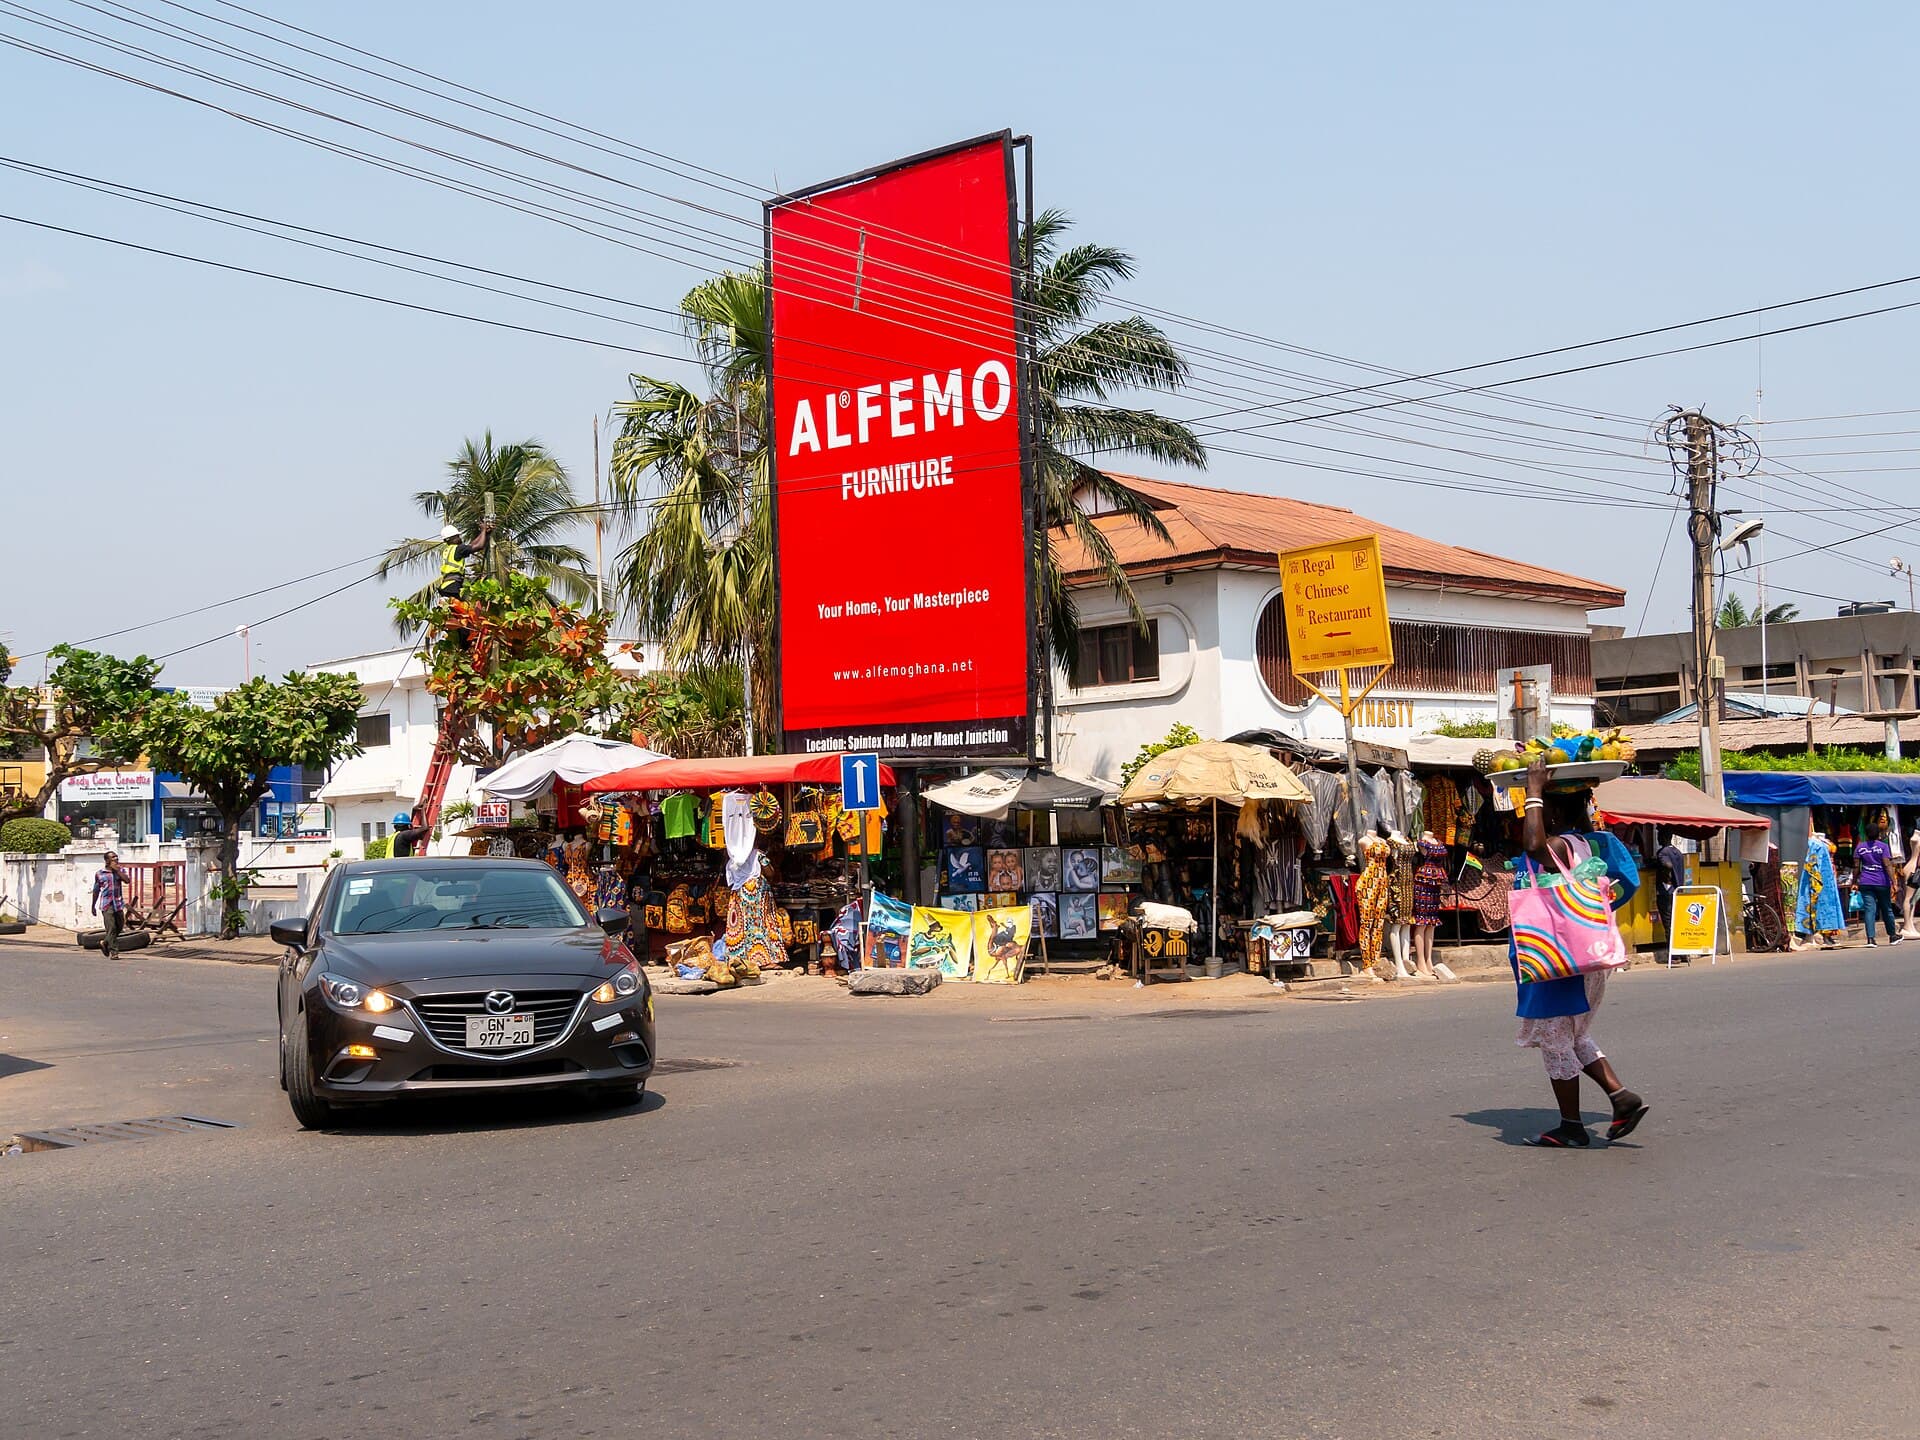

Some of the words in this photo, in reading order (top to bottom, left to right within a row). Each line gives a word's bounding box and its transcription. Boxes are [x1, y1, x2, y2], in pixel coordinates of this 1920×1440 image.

[789, 360, 1011, 457] ALFEMO
[842, 455, 954, 501] FURNITURE
[1302, 554, 1335, 577] Regal
[1305, 583, 1350, 600] Chinese
[817, 604, 842, 619] Your
[845, 601, 881, 616] Home,
[884, 597, 910, 612] Your
[913, 588, 990, 608] Masterpiece
[1308, 606, 1373, 625] Restaurant
[833, 658, 973, 680] www.alfemoghana.net
[806, 738, 847, 752] Location:
[848, 735, 882, 751] Spintex
[883, 733, 909, 748] Road,
[911, 733, 932, 746] Near
[933, 731, 963, 746] Manet
[965, 729, 1009, 745] Junction
[477, 804, 507, 817] IELTS
[488, 1018, 505, 1031] GN
[479, 1031, 530, 1046] 977-20
